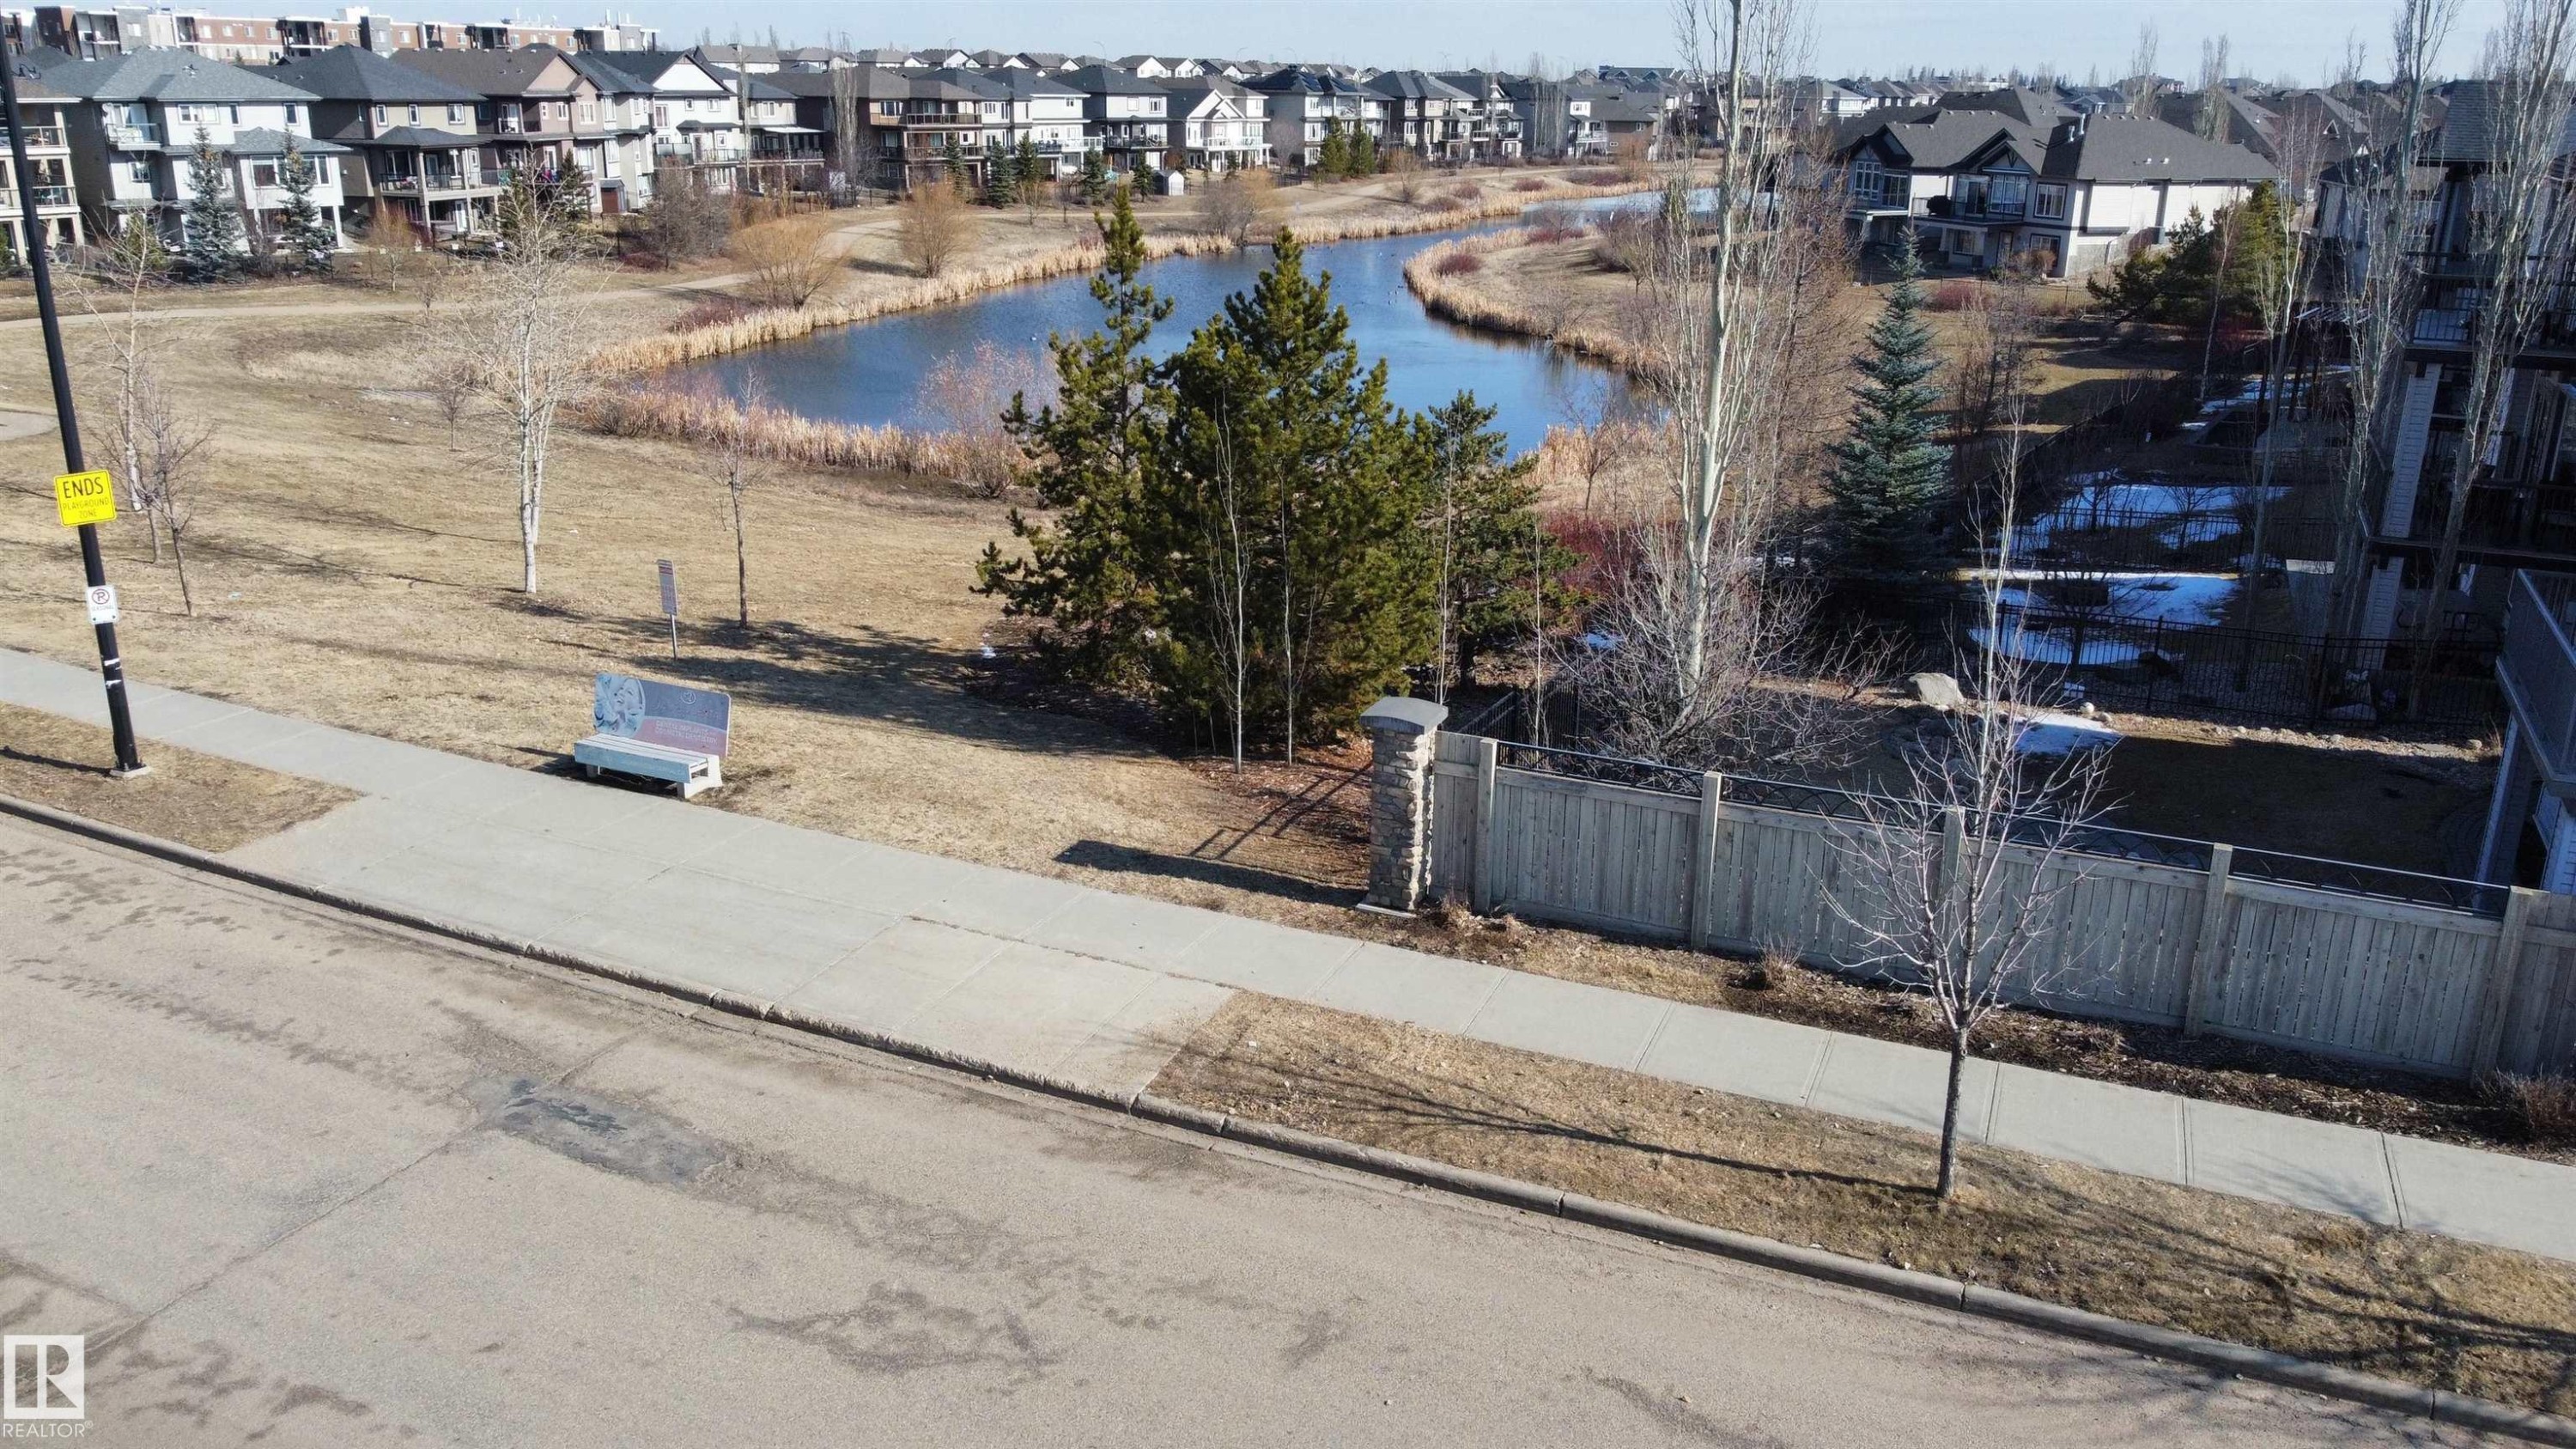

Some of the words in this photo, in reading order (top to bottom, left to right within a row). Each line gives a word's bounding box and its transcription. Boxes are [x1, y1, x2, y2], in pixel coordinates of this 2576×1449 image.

[63, 477, 104, 499] ENDS
[62, 496, 109, 511] PLAYGROUND
[79, 508, 97, 519] ZONE
